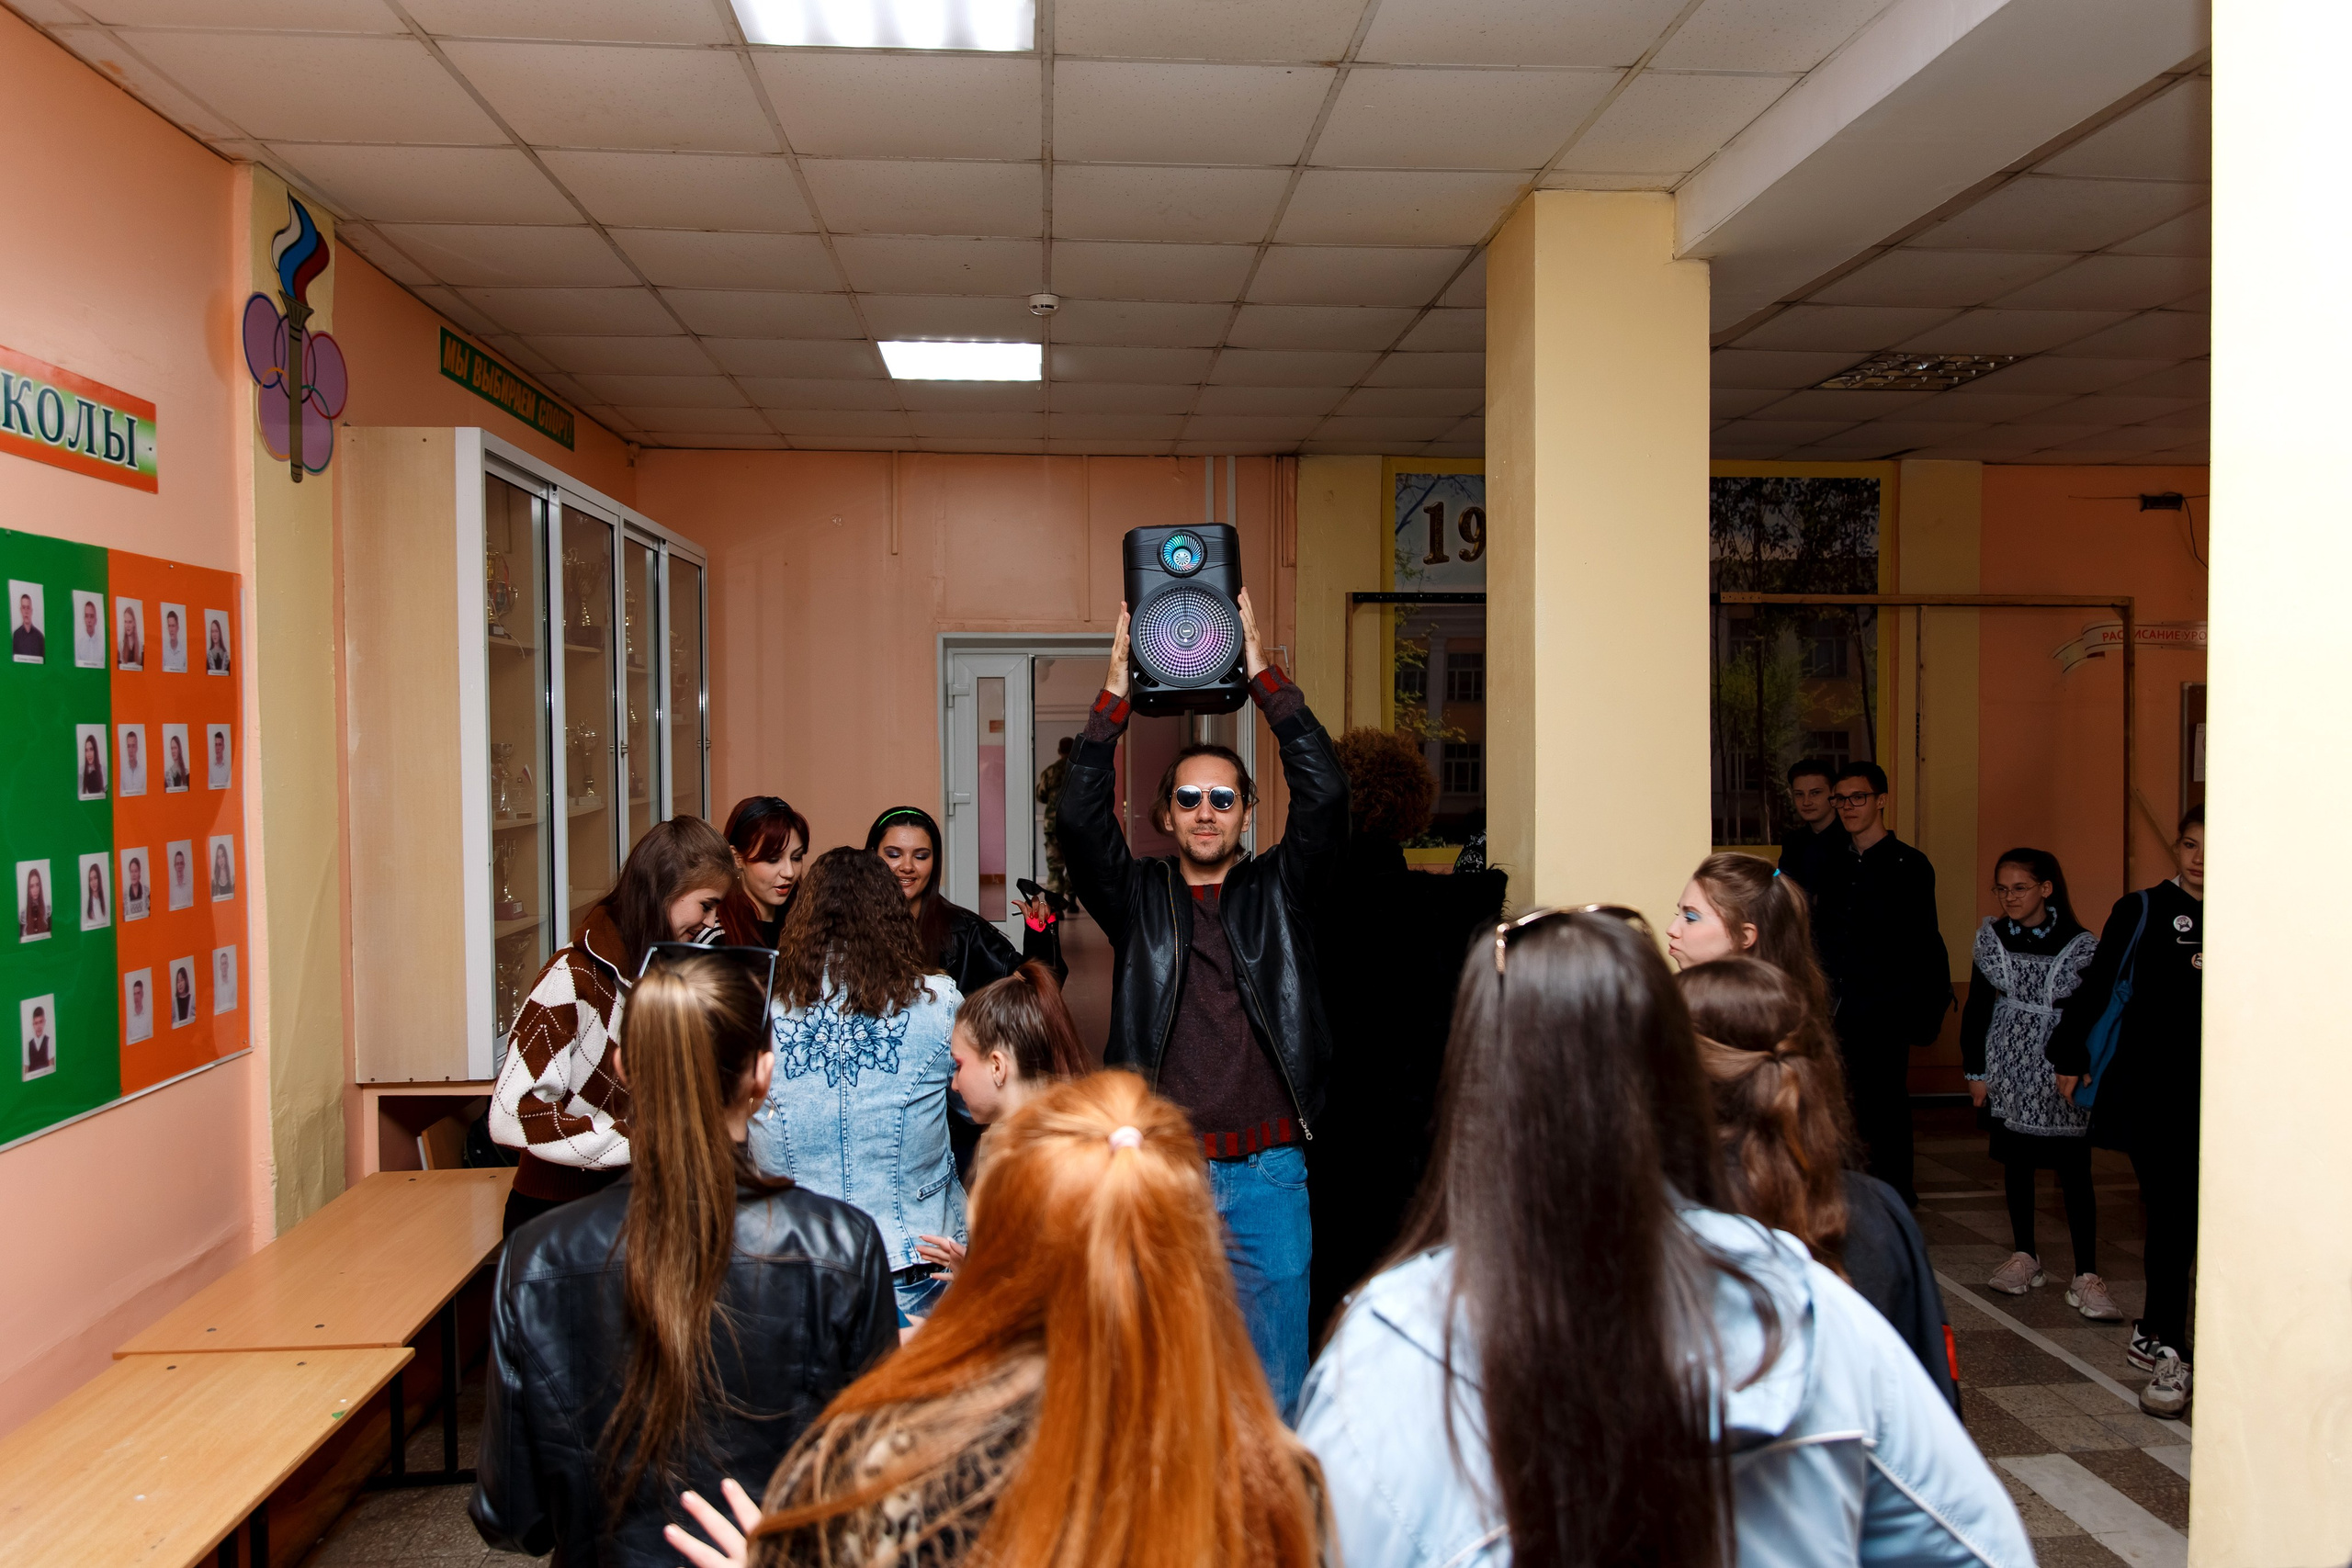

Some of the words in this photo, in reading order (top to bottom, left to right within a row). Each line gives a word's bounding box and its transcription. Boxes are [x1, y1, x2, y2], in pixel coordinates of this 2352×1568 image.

[1, 371, 139, 468] КОЛЫ
[443, 335, 469, 380] МЫ
[472, 355, 537, 422] ВЫБИРАЕМ
[537, 399, 574, 445] СПОРТ!
[1423, 501, 1487, 566] 19
[2102, 629, 2181, 642] РАСИСАНИЕ
[2183, 630, 2207, 641] УРО
